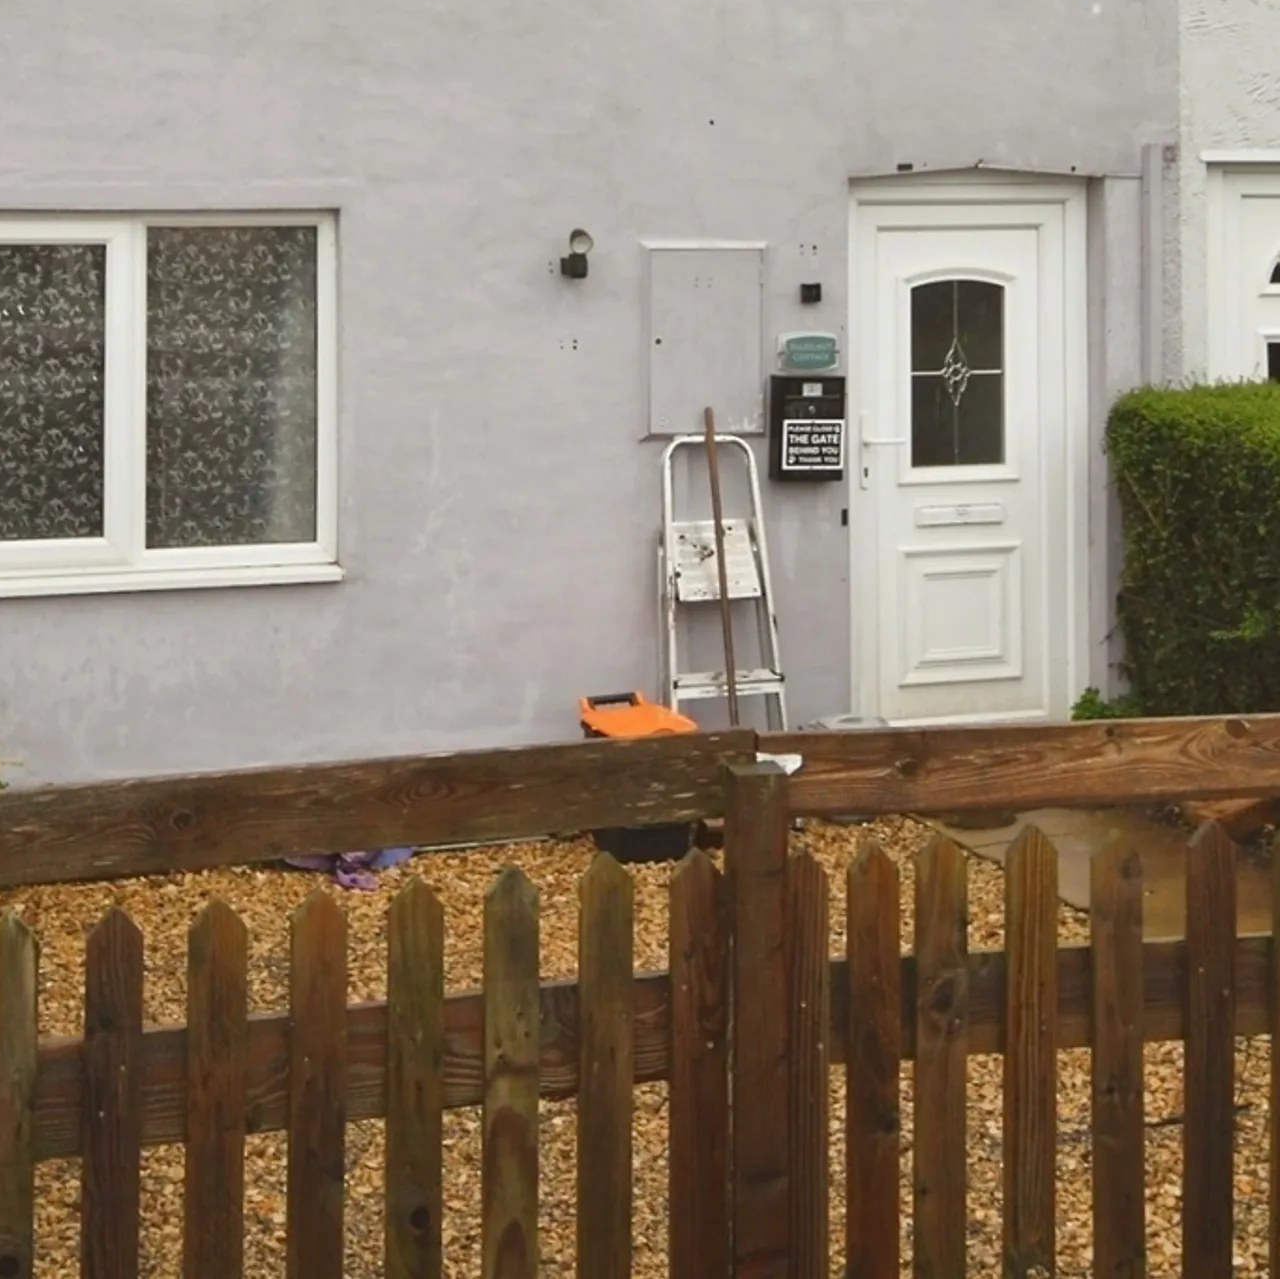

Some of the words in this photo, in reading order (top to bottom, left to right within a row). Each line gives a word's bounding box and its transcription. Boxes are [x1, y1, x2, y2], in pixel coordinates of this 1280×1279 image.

[788, 434, 810, 445] THE
[810, 434, 839, 445] GATE
[788, 446, 820, 455] BEHIND
[821, 446, 838, 455] YOU
[824, 456, 838, 464] YOU
